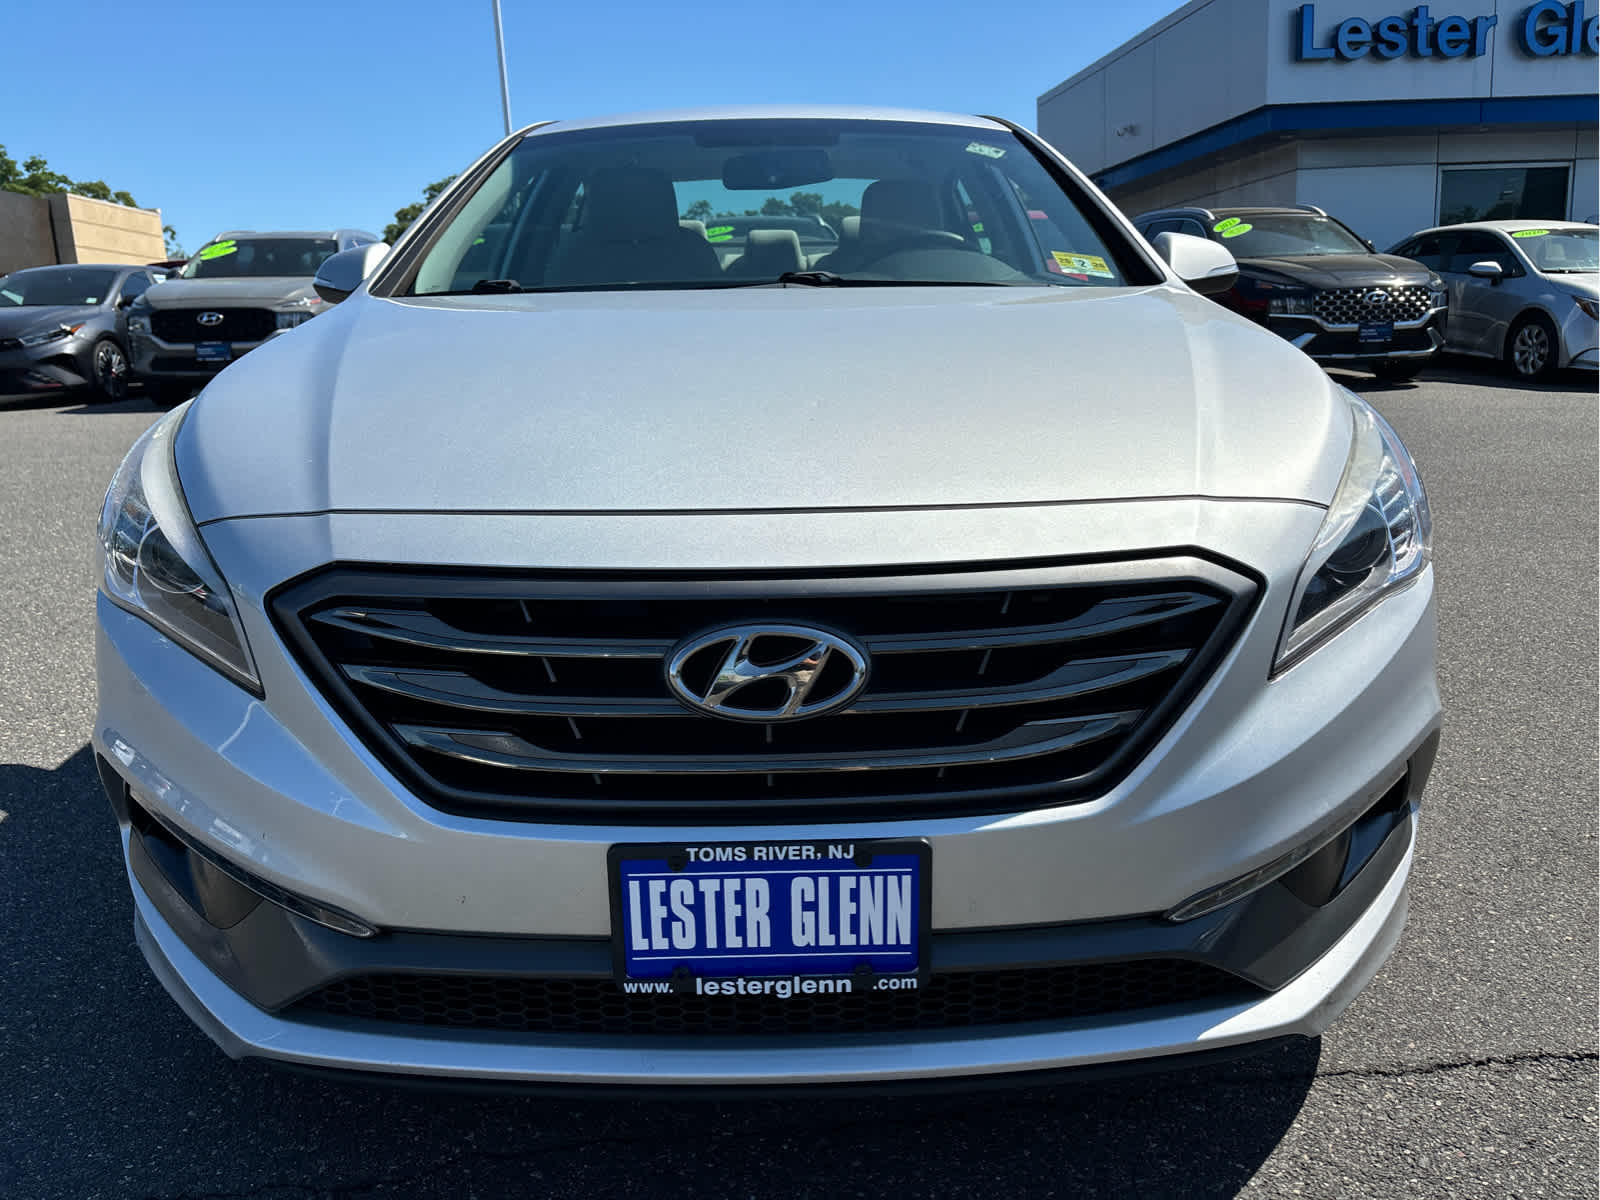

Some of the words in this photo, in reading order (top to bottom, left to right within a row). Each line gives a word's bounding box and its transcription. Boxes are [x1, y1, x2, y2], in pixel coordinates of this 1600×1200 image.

[1299, 3, 1497, 60] Lester
[685, 846, 748, 862] TOMS
[753, 845, 822, 861] RIVER,
[828, 844, 855, 860] NJ
[628, 877, 771, 951] LESTER
[791, 874, 912, 948] GLENN
[623, 981, 675, 994] www.
[696, 976, 852, 999] lesterglenn
[872, 977, 918, 991] .com
